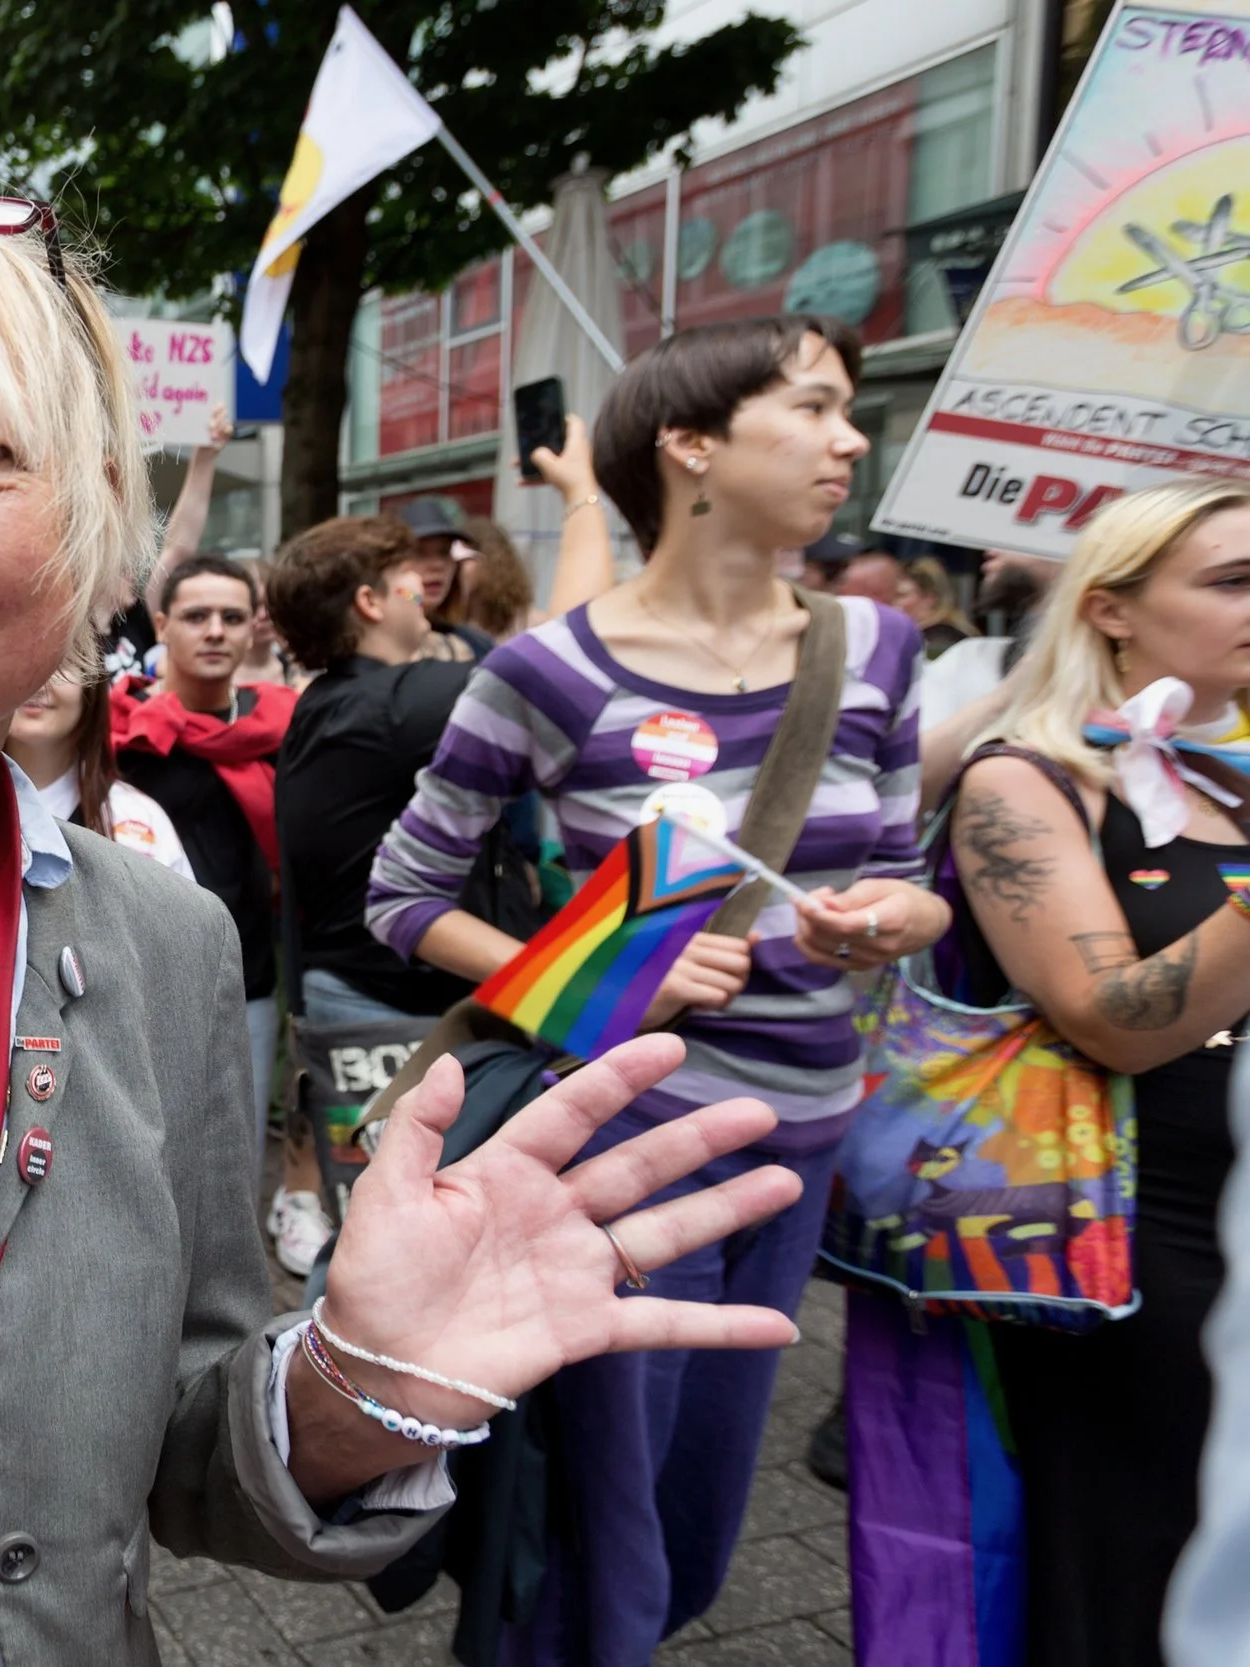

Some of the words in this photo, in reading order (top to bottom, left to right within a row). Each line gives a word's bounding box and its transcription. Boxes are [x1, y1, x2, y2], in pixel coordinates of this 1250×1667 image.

[162, 383, 208, 415] again
[960, 463, 1022, 504] Die
[25, 1038, 60, 1049] PARTEI
[329, 1042, 423, 1093] BO
